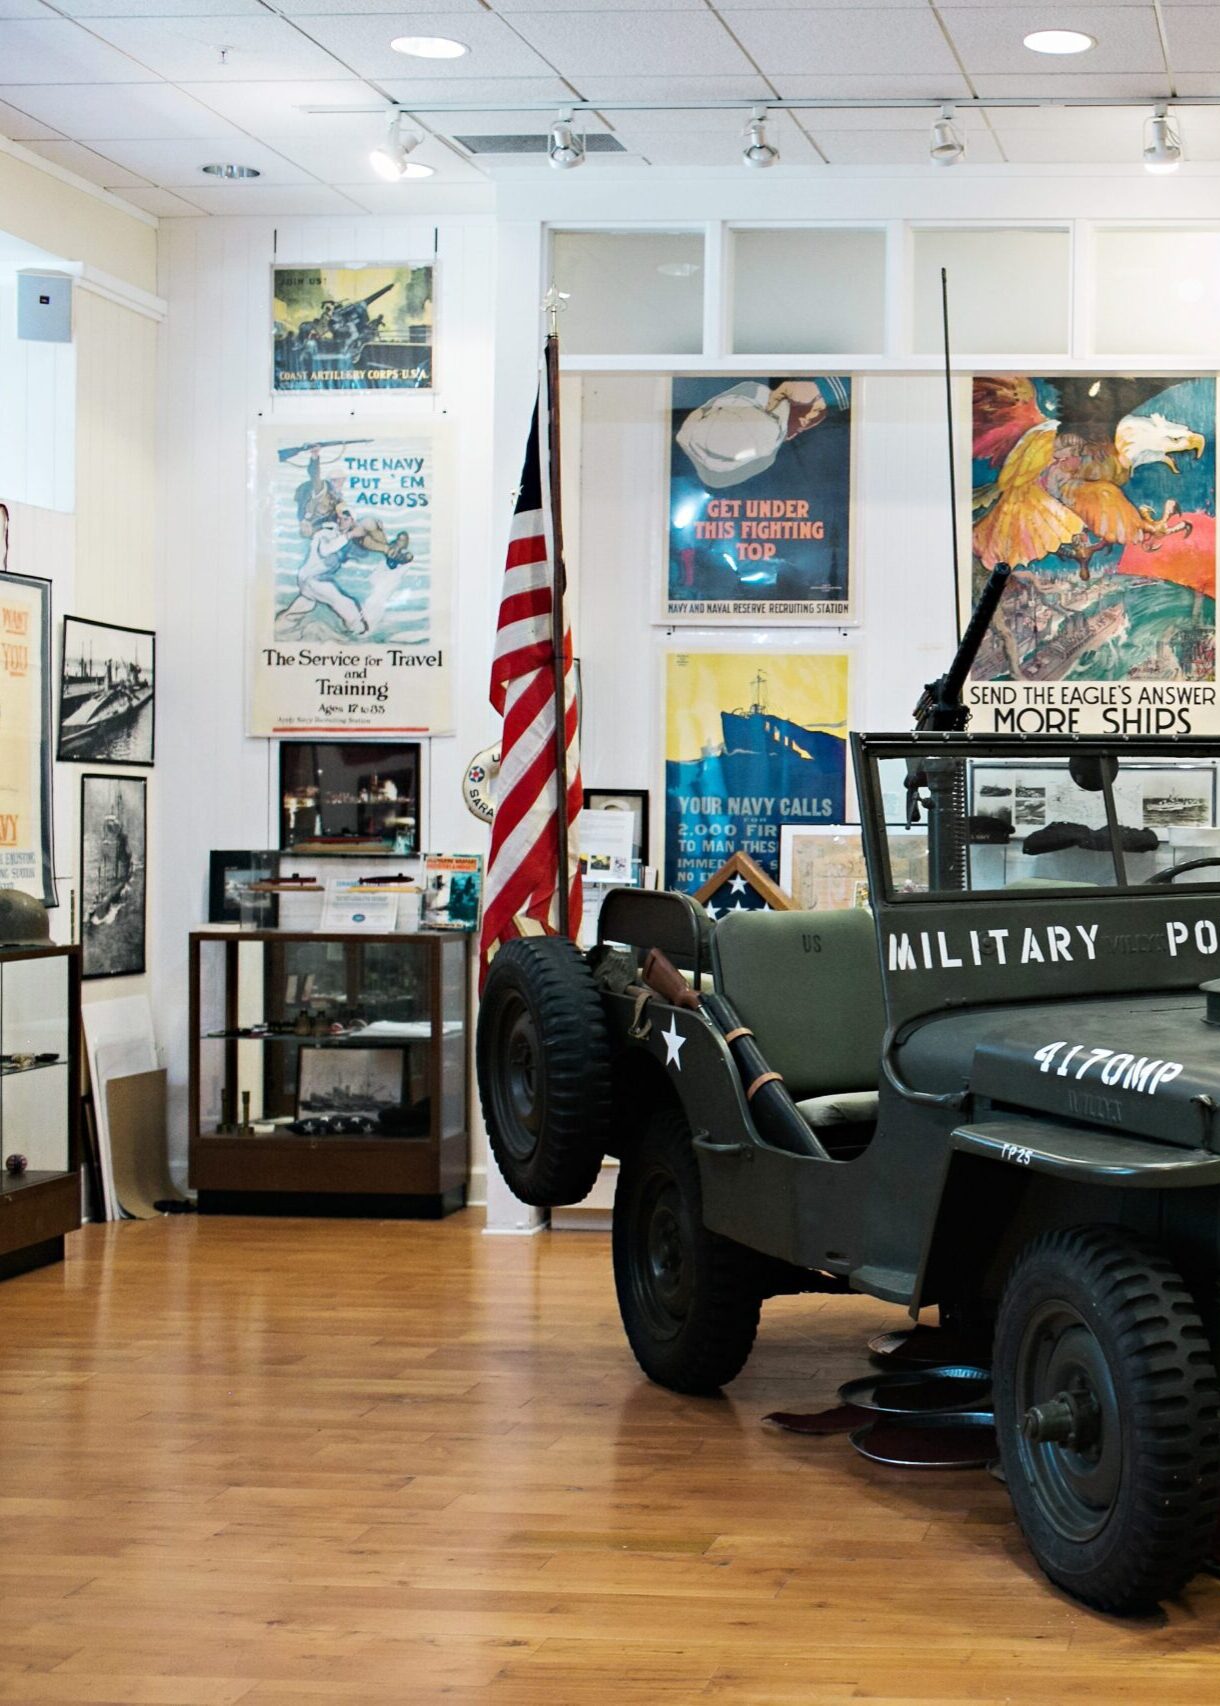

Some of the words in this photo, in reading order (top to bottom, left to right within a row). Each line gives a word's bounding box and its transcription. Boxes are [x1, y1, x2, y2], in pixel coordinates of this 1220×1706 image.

[280, 371, 308, 381] COAST
[310, 370, 365, 380] ARTILLERY
[367, 369, 398, 380] CORPS
[344, 457, 380, 471] THE
[382, 457, 424, 474] NAVY
[350, 476, 381, 489] PUT
[356, 492, 429, 508] ACROSS
[707, 500, 742, 518] GET
[746, 500, 809, 518] UNDER
[694, 521, 735, 540] THIS
[741, 521, 824, 540] FIGHTING
[736, 543, 777, 561] TOP
[668, 603, 688, 614] NAVY
[689, 603, 705, 614] AND
[707, 603, 731, 614] NAVAL
[733, 603, 766, 614] RESERVE
[769, 603, 814, 614] RECRUITING
[816, 603, 849, 614] STATION
[1, 643, 28, 671] YOU
[263, 649, 296, 667] The
[299, 649, 360, 667] Service
[365, 655, 383, 667] for
[387, 650, 443, 667] Travel
[344, 668, 367, 679] and
[316, 678, 389, 701] Training
[970, 686, 1017, 705] SEND
[1023, 686, 1055, 705] THE
[1061, 685, 1132, 705] EAGLE'S
[1138, 686, 1216, 706] ANSWER
[318, 703, 344, 716] Ages
[348, 703, 359, 713] 17
[994, 708, 1080, 733] MORE
[1102, 708, 1192, 734] SHIPS
[469, 789, 495, 817] SARA
[678, 796, 723, 816] YOUR
[727, 797, 776, 816] NAVY
[779, 798, 833, 817] CALLS
[746, 824, 777, 837] FIR
[678, 840, 696, 852] TO
[702, 840, 735, 852] MAN
[741, 840, 776, 853] THES
[678, 871, 694, 882] NO
[802, 933, 821, 953] US
[888, 924, 1099, 971] MILITARY
